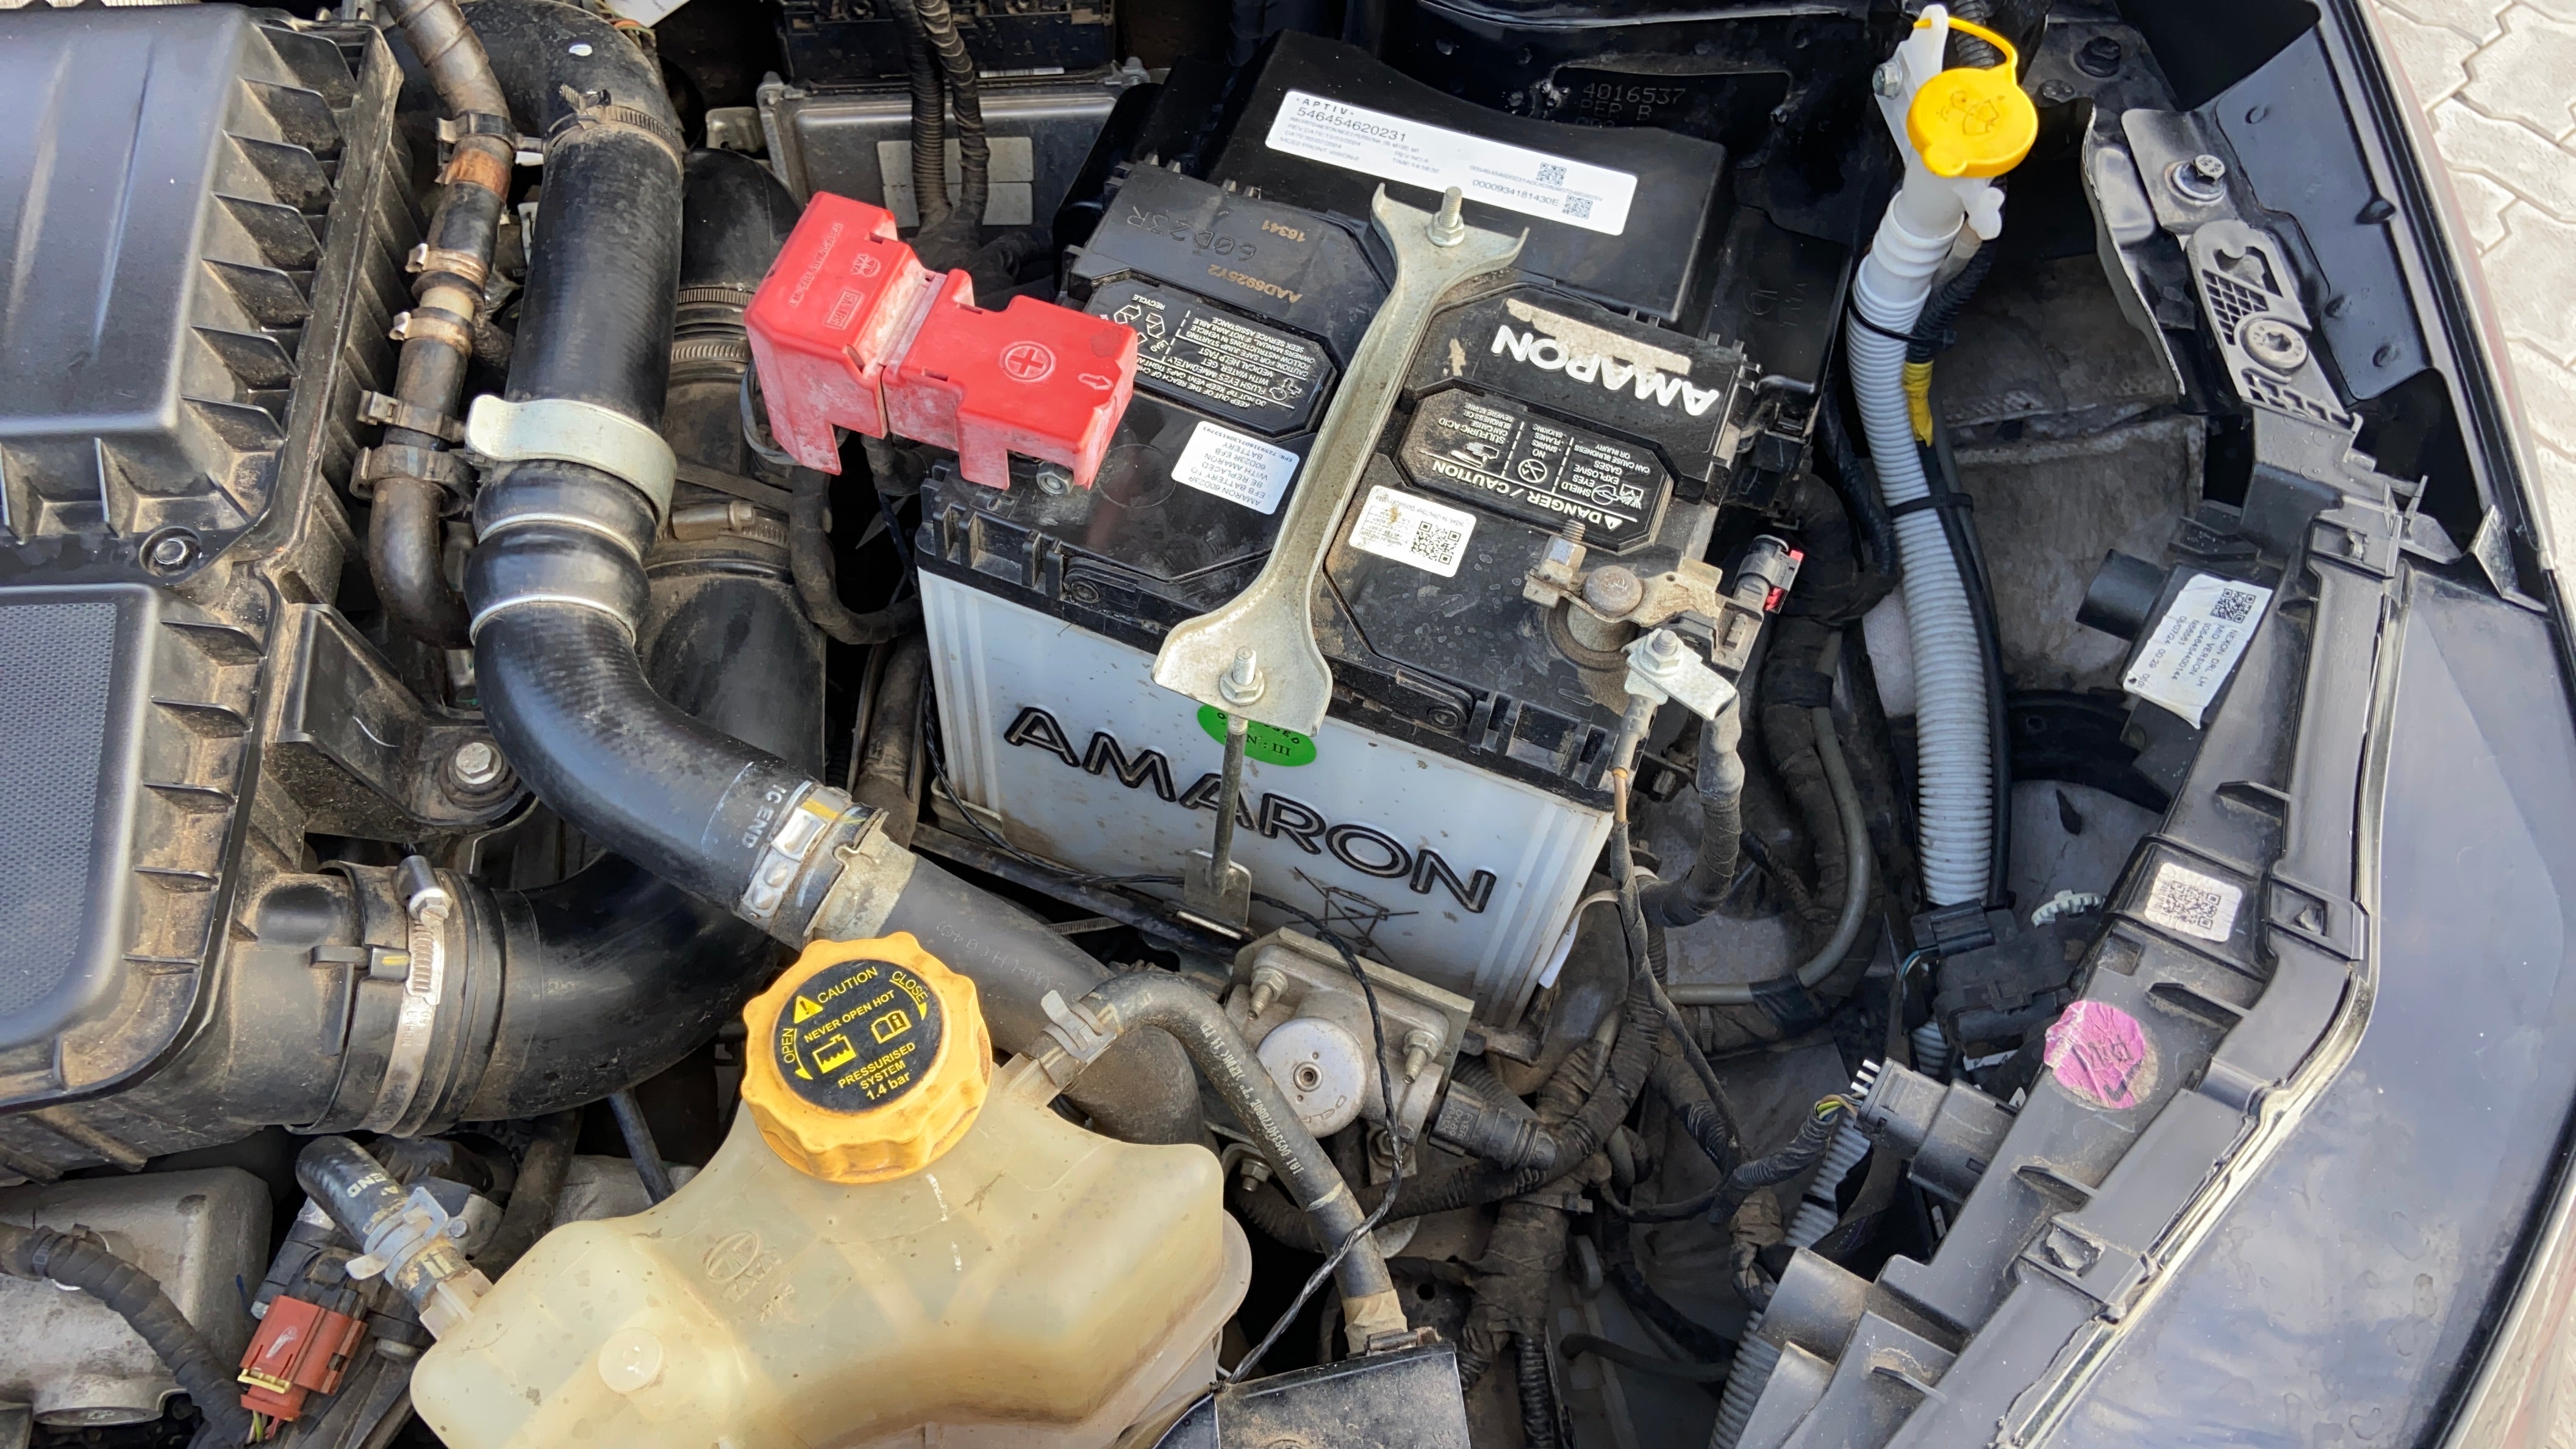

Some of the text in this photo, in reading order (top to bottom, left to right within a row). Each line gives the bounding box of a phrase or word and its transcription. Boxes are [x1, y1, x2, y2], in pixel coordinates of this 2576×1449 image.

[1583, 81, 1686, 104] 4016537
[1302, 98, 1348, 115] APTIV
[1297, 106, 1406, 143] 546454620231
[1261, 218, 1306, 243] 16341
[1132, 293, 1165, 310] RECYCLE
[1192, 317, 1225, 334] AVAILABLE
[1223, 327, 1239, 338] NOT
[1185, 331, 1219, 348] STARTING
[1239, 332, 1250, 342] IF
[1255, 330, 1286, 346] SERVICE
[1190, 324, 1311, 370] FOLLOW INSTRUCTIONS IN VEHICLE
[1220, 342, 1240, 354] JUMP
[1285, 340, 1305, 352] SEEK
[1198, 346, 1274, 377] MEDICAL HELP FAST
[1200, 357, 1218, 369] GET
[1240, 349, 1259, 361] SAFE
[1259, 356, 1275, 367] FOR
[1283, 347, 1315, 364] OWNERS
[1143, 359, 1165, 372] TIGHT
[1150, 368, 1161, 378] OF
[1165, 367, 1186, 379] CAPS
[1490, 326, 1719, 416] AMARON
[1162, 373, 1187, 387] REACH
[1166, 354, 1266, 395] FLUSH EYES IMMEDIATELY
[1187, 374, 1205, 385] VENT
[1248, 373, 1269, 386] WITH
[1187, 382, 1202, 392] THE
[1202, 387, 1214, 396] OF
[1206, 381, 1226, 393] KEEP
[1214, 390, 1229, 401] OUT
[1239, 392, 1254, 402] NOT
[1254, 397, 1266, 406] DO
[1470, 420, 1509, 436] CAN CAUSE
[1475, 412, 1511, 429] BLINDNESS
[1437, 417, 1505, 443] SULFURIC ACID
[1214, 447, 1266, 470] 60D23R EFB
[1221, 440, 1263, 460] BATTERY
[1531, 448, 1546, 459] NO
[1573, 444, 1650, 473] CAN CAUSE BLINDNESS
[1595, 442, 1631, 459] OR INJURY
[1201, 460, 1262, 488] BE REPLACED
[1203, 453, 1268, 481] WITH AMARON
[1573, 463, 1620, 484] EXPLOSIVE
[1593, 460, 1623, 475] GASES
[1189, 467, 1265, 498] EFB BATTERY TO
[1431, 461, 1510, 495] CAUTION
[1572, 473, 1595, 487] EYES
[1187, 475, 1261, 506] AMARON 60D23R
[1561, 481, 1591, 496] SHIELD
[1526, 490, 1602, 523] DANGER
[2189, 624, 2225, 677] MID VERSION
[2197, 628, 2238, 688] NEXON DRL LH
[1002, 704, 1498, 914] AMARON
[738, 803, 775, 850] END
[818, 967, 879, 1004] CAUTION
[892, 970, 928, 1006] CLOSE
[804, 990, 895, 1043] NEVER OPEN HOT
[782, 1029, 795, 1064] OPEN
[838, 1042, 917, 1089] PRESSURISED
[860, 1061, 906, 1090] SYSTEM
[867, 1072, 911, 1100] 1.4 bar
[344, 1168, 388, 1198] END
